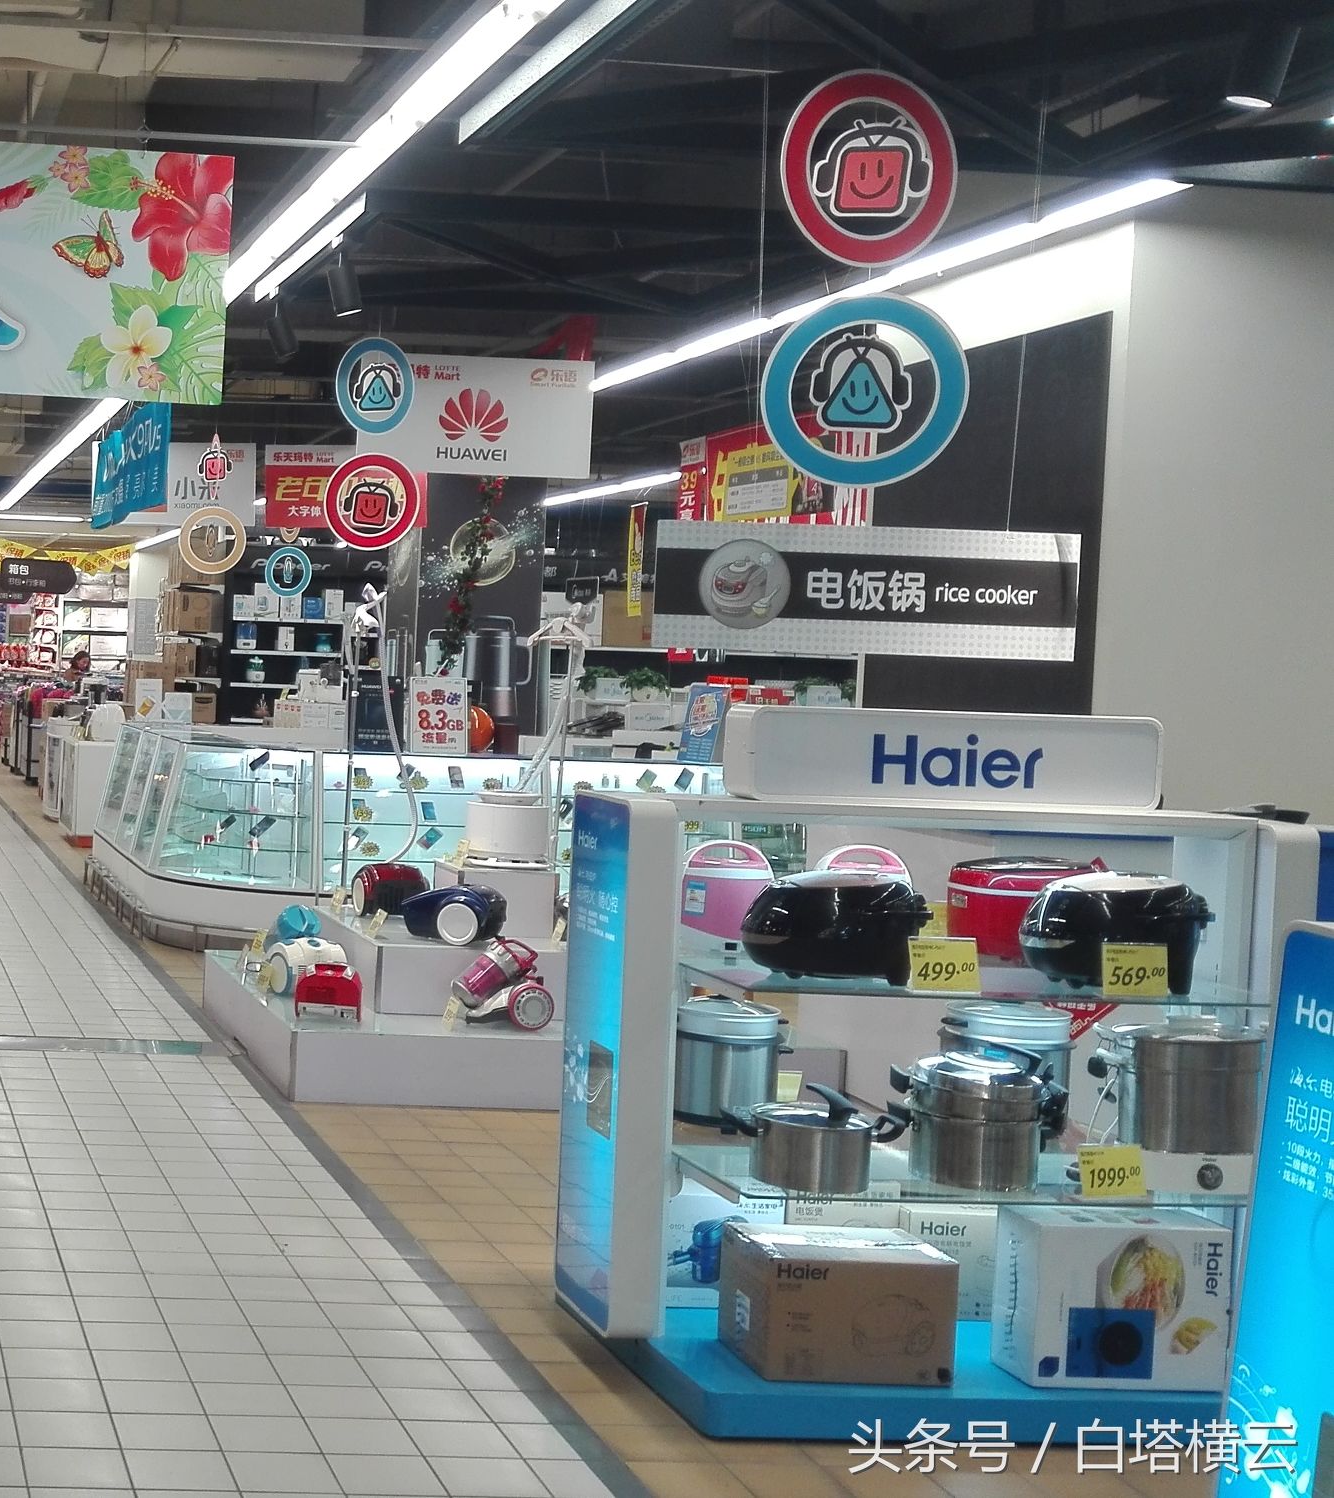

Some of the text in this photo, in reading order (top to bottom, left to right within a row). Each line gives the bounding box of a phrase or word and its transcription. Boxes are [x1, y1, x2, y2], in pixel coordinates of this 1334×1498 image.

[434, 371, 460, 381] Mart
[272, 451, 314, 463] 乐天玛特
[435, 446, 508, 462] HUAWEI
[8, 563, 30, 576] 箱包
[806, 568, 926, 613] 电饭锅
[934, 583, 1039, 607] rice cooker
[417, 708, 464, 731] 8.3GB
[872, 733, 1044, 789] Haier
[577, 828, 598, 851] Haier
[917, 962, 976, 982] 499.00
[1108, 965, 1167, 987] 569.00
[1294, 994, 1334, 1036] Ha
[1088, 1165, 1141, 1189] 1999.00
[795, 1190, 835, 1206] Haier
[795, 1206, 824, 1217] 电饭煲
[920, 1220, 968, 1237] Haier
[776, 1262, 830, 1281] Haier
[1205, 1241, 1224, 1298] Haier
